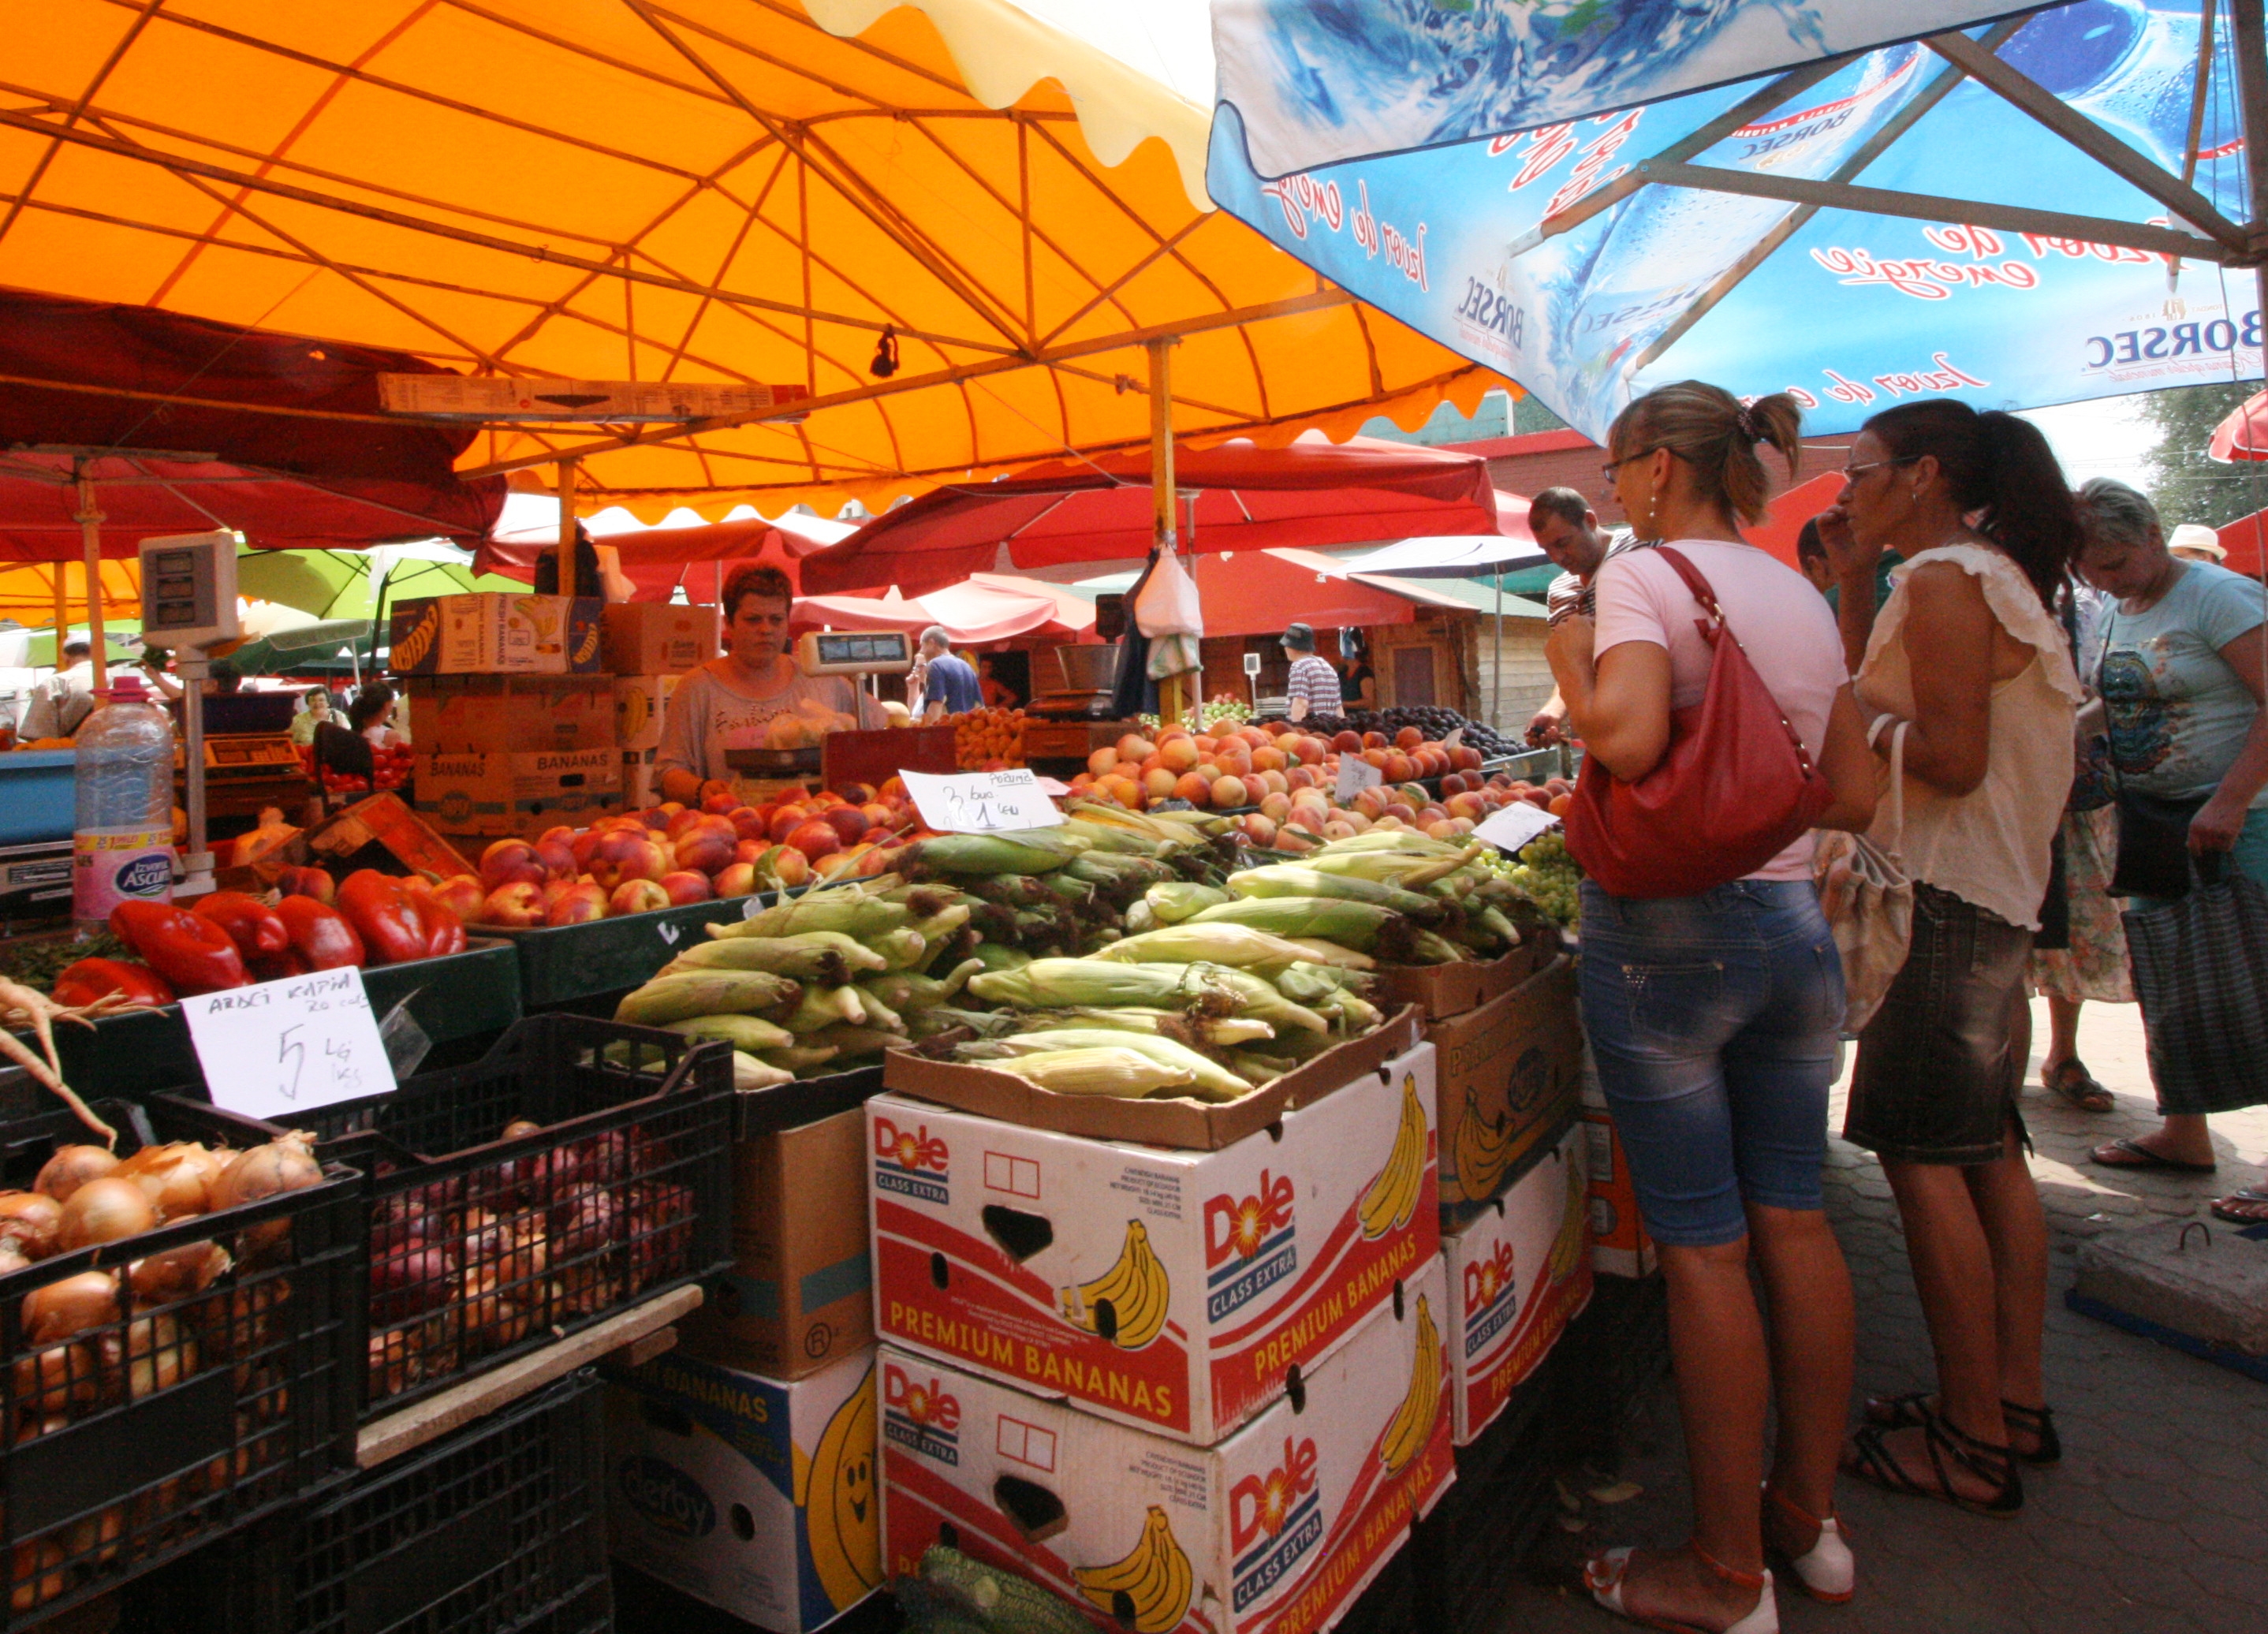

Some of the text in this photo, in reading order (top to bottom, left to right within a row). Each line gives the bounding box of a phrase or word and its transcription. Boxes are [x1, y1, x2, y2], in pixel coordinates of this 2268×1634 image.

[430, 759, 486, 778] BANANAS
[536, 753, 608, 770] BANANAS
[874, 1115, 949, 1171] Dole
[877, 1173, 947, 1203] CLASS EXTRA
[1203, 1167, 1295, 1270] Dole
[1211, 1252, 1295, 1316] CLASS EXTRA
[1254, 1233, 1417, 1382] PREMIUM BANANAS
[1464, 1238, 1514, 1317] Dole
[890, 1300, 1014, 1368] PREMIUM
[1025, 1346, 1173, 1418] BANANAS
[1468, 1300, 1516, 1353] CLASS EXTRA
[666, 1368, 769, 1423] BANANAS
[883, 1363, 961, 1431] Dole
[1490, 1327, 1541, 1399] PREMIUM
[887, 1423, 957, 1464] CLASS EXTRA
[1229, 1434, 1319, 1558] Dole
[1237, 1519, 1322, 1606] CLASS EXTRA
[1278, 1455, 1433, 1634] PREMIUM BANANAS
